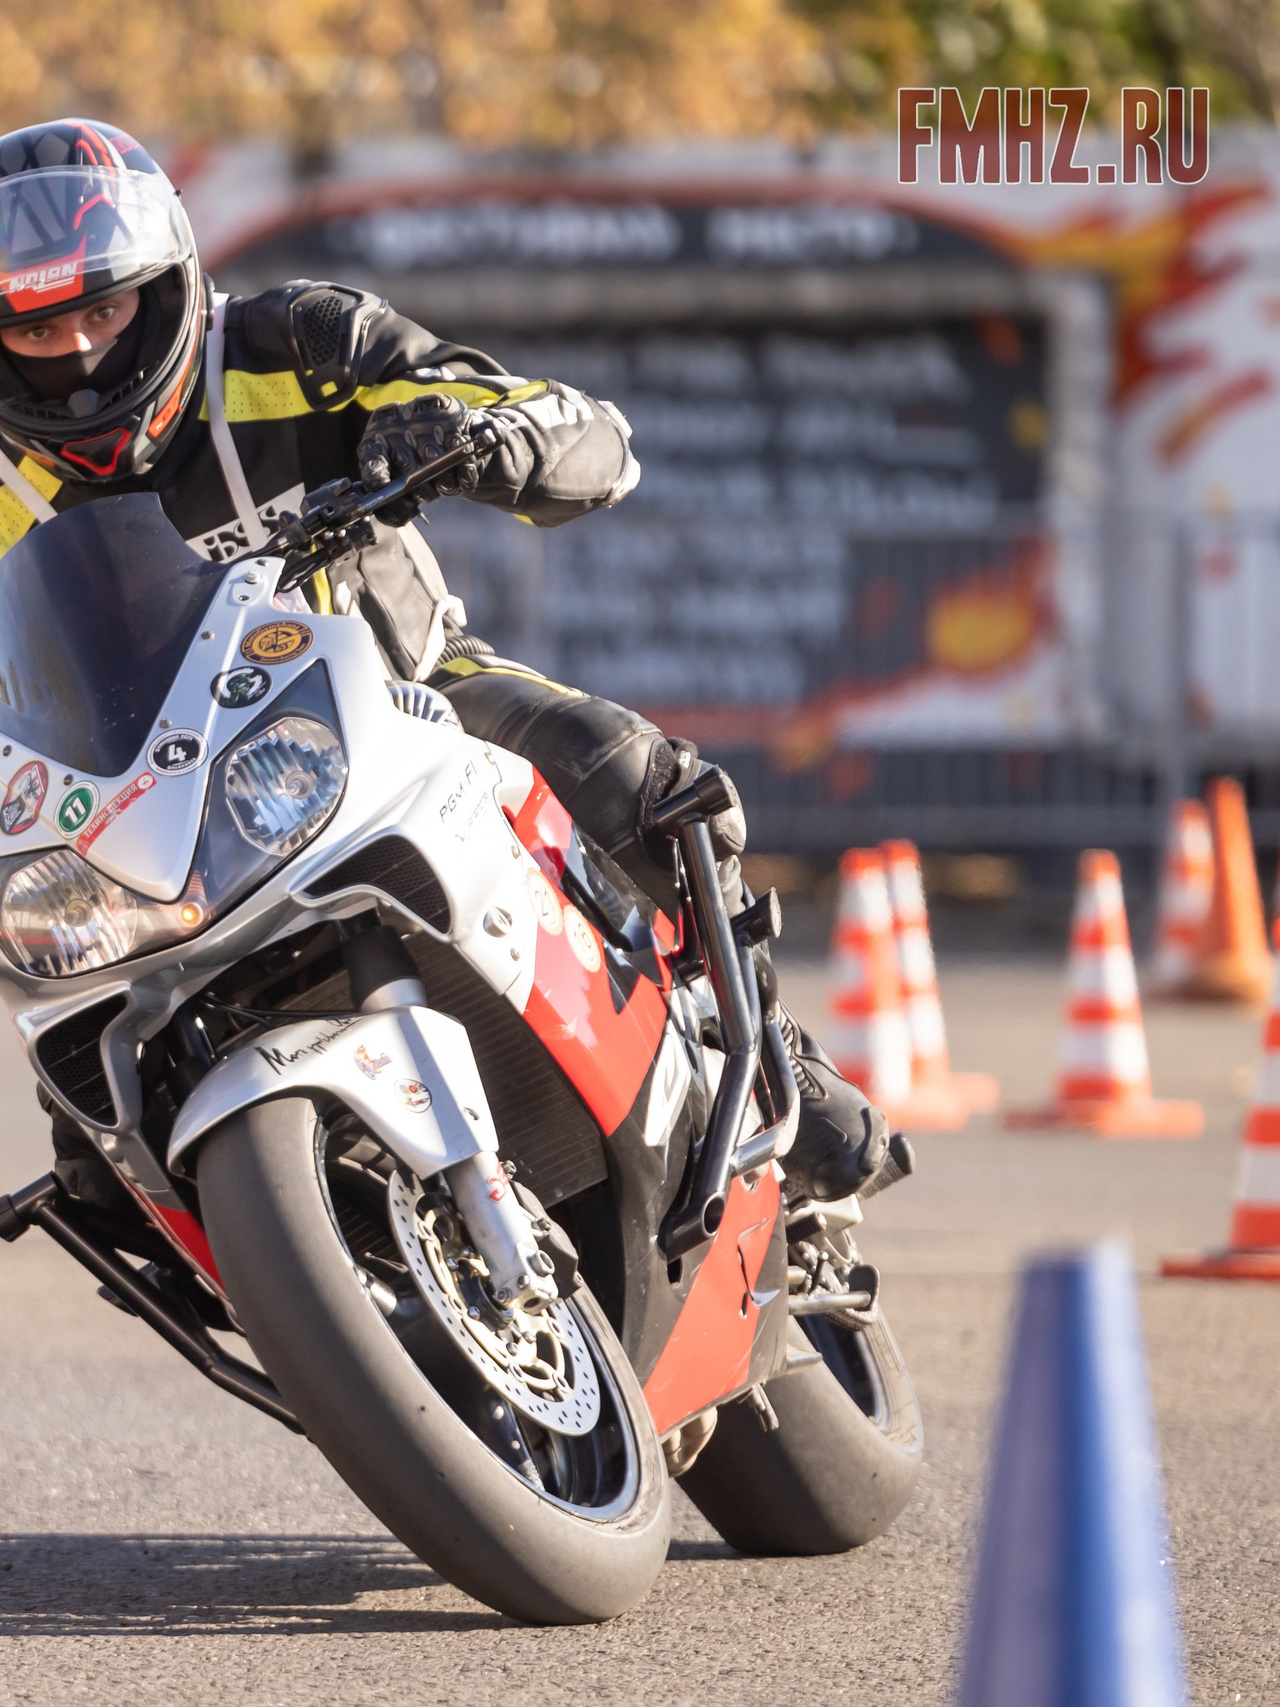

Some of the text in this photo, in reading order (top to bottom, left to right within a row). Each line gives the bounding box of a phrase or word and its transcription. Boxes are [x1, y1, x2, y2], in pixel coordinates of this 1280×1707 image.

[8, 261, 78, 293] NOLAN
[167, 743, 187, 762] 4
[65, 797, 86, 824] 11
[84, 783, 139, 839] ТЕХИНСПЕКЦИЯ
